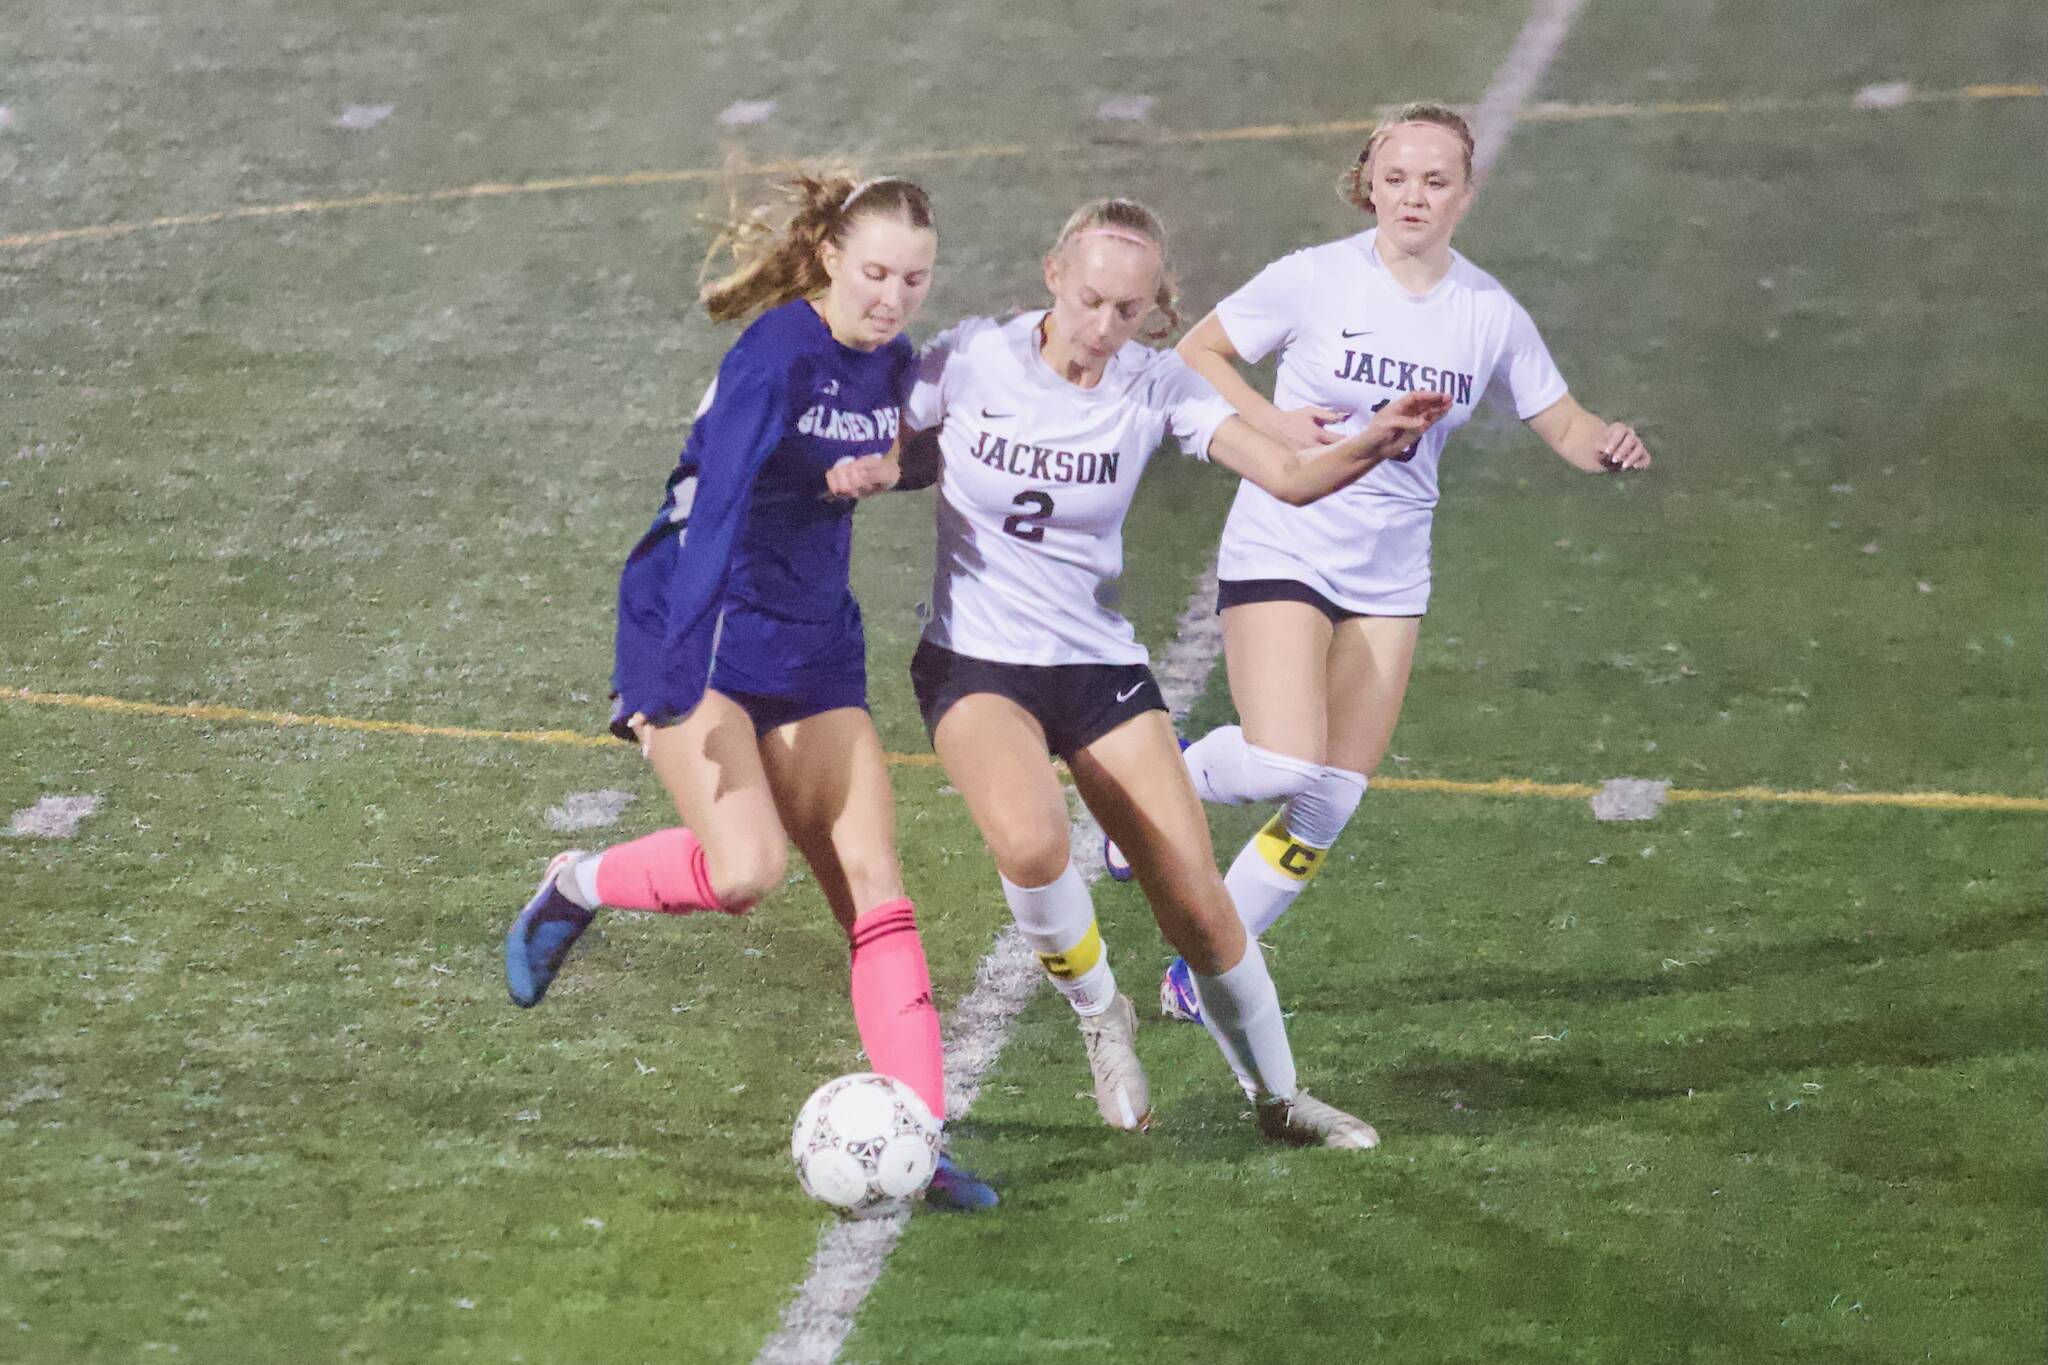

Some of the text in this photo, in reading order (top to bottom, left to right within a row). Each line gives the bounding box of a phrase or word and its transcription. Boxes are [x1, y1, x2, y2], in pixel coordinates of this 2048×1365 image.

[1334, 349, 1473, 405] JACKSON
[872, 406, 900, 440] PE
[970, 431, 1120, 485] JACKSON
[1002, 490, 1055, 543] 2
[1279, 843, 1317, 875] C
